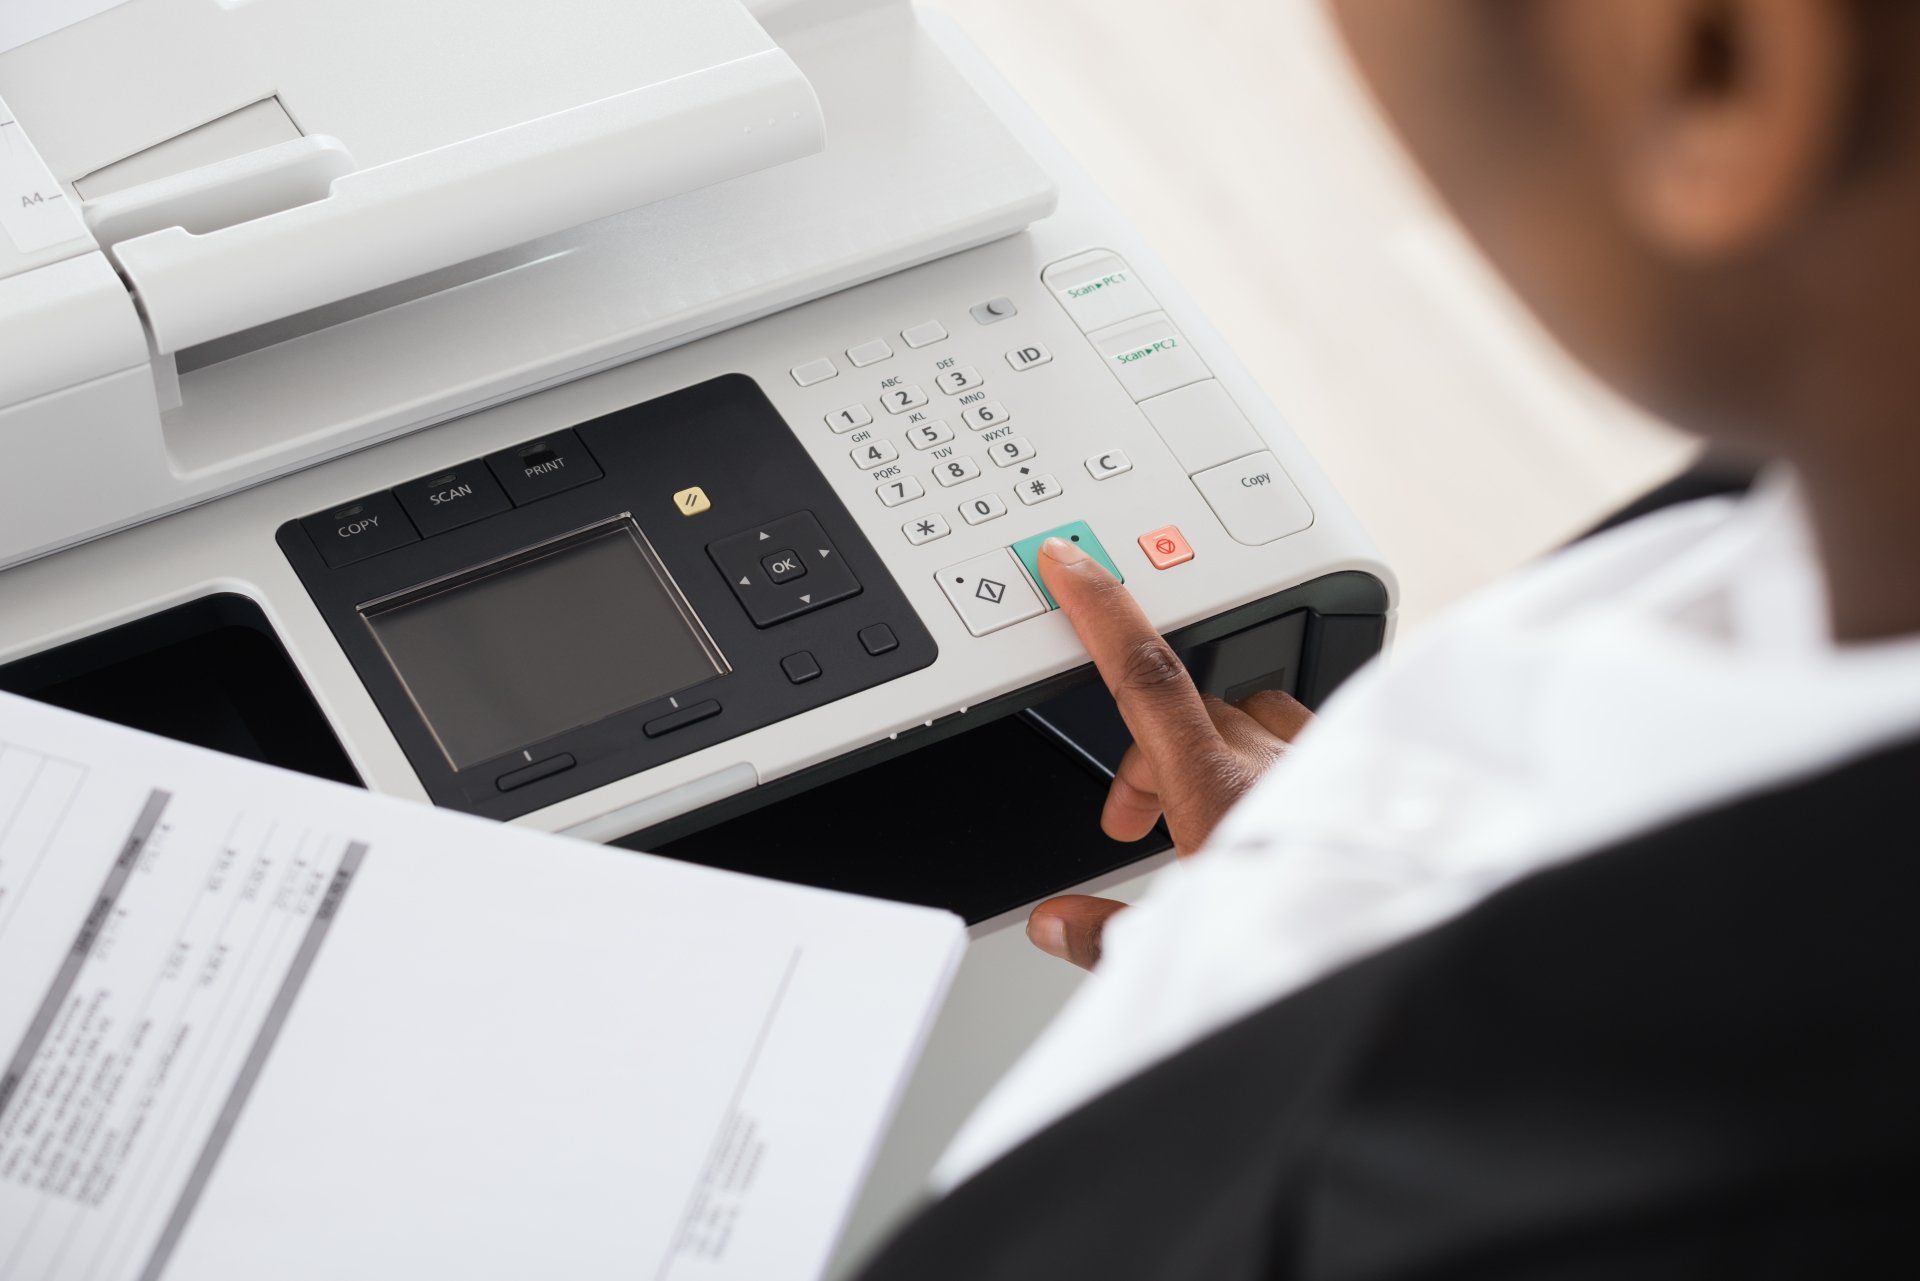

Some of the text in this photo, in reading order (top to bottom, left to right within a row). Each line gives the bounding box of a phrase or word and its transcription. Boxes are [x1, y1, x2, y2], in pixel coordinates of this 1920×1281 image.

[22, 191, 44, 208] A4
[1017, 347, 1041, 364] ID
[936, 357, 956, 370] DEF
[881, 376, 902, 389] ABC
[950, 372, 967, 386] 3
[895, 391, 912, 405] 2
[959, 391, 986, 406] MNO
[841, 411, 855, 424] 1
[908, 412, 927, 424] JKL
[978, 406, 994, 421] 6
[851, 430, 872, 443] GHI
[921, 426, 938, 441] 5
[982, 426, 1014, 442] WXYZ
[868, 446, 882, 459] 4
[931, 446, 953, 460] TUV
[1004, 443, 1019, 458] 9
[524, 457, 565, 478] PRINT
[948, 463, 965, 478] 8
[1100, 455, 1117, 471] C
[873, 465, 901, 481] PQRS
[1241, 472, 1271, 488] Copy
[430, 484, 473, 506] SCAN
[891, 482, 905, 498] 7
[1030, 480, 1047, 496] #
[974, 500, 991, 516] 0
[338, 516, 379, 538] COPY
[772, 558, 796, 574] OK
